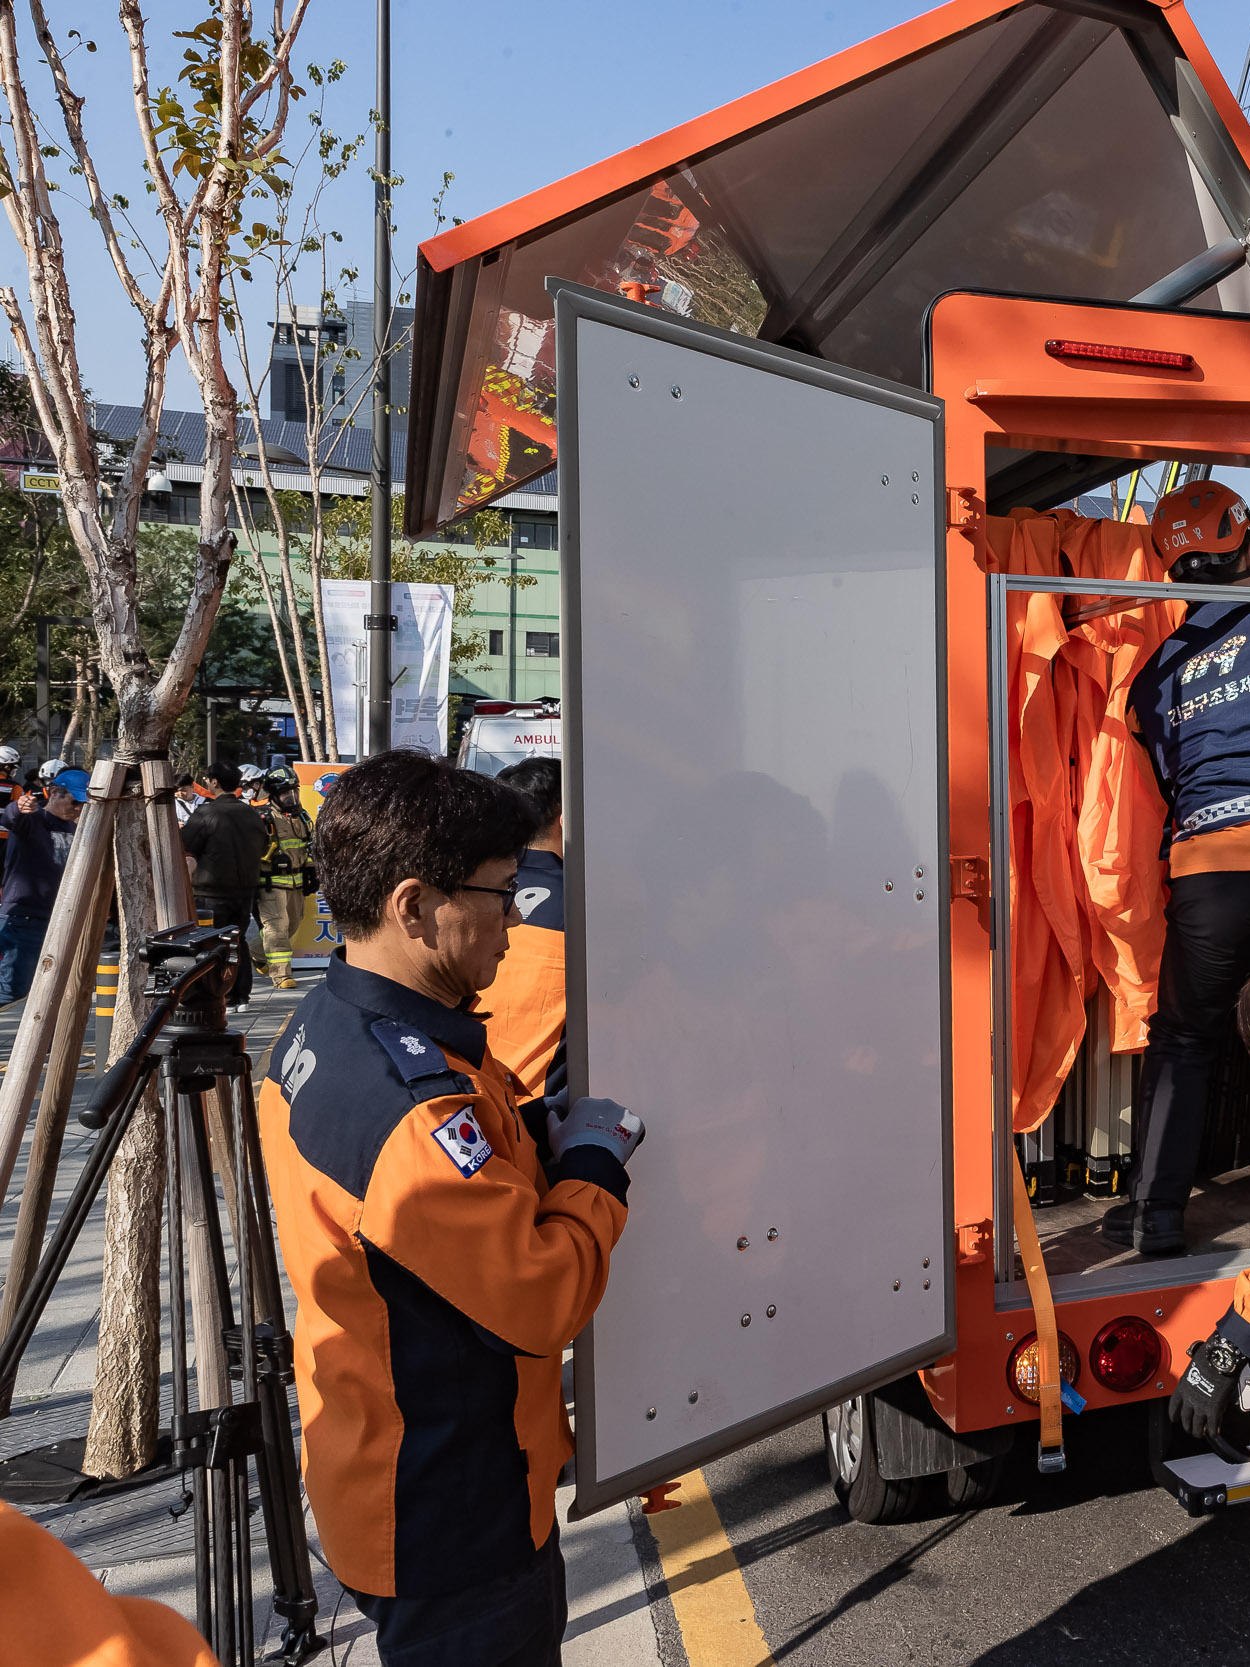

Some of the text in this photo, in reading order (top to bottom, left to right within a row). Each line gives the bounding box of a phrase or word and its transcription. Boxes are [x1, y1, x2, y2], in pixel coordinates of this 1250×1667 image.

[29, 477, 60, 488] CCTV
[615, 1123, 632, 1140] 3M
[467, 1143, 493, 1171] KORE
